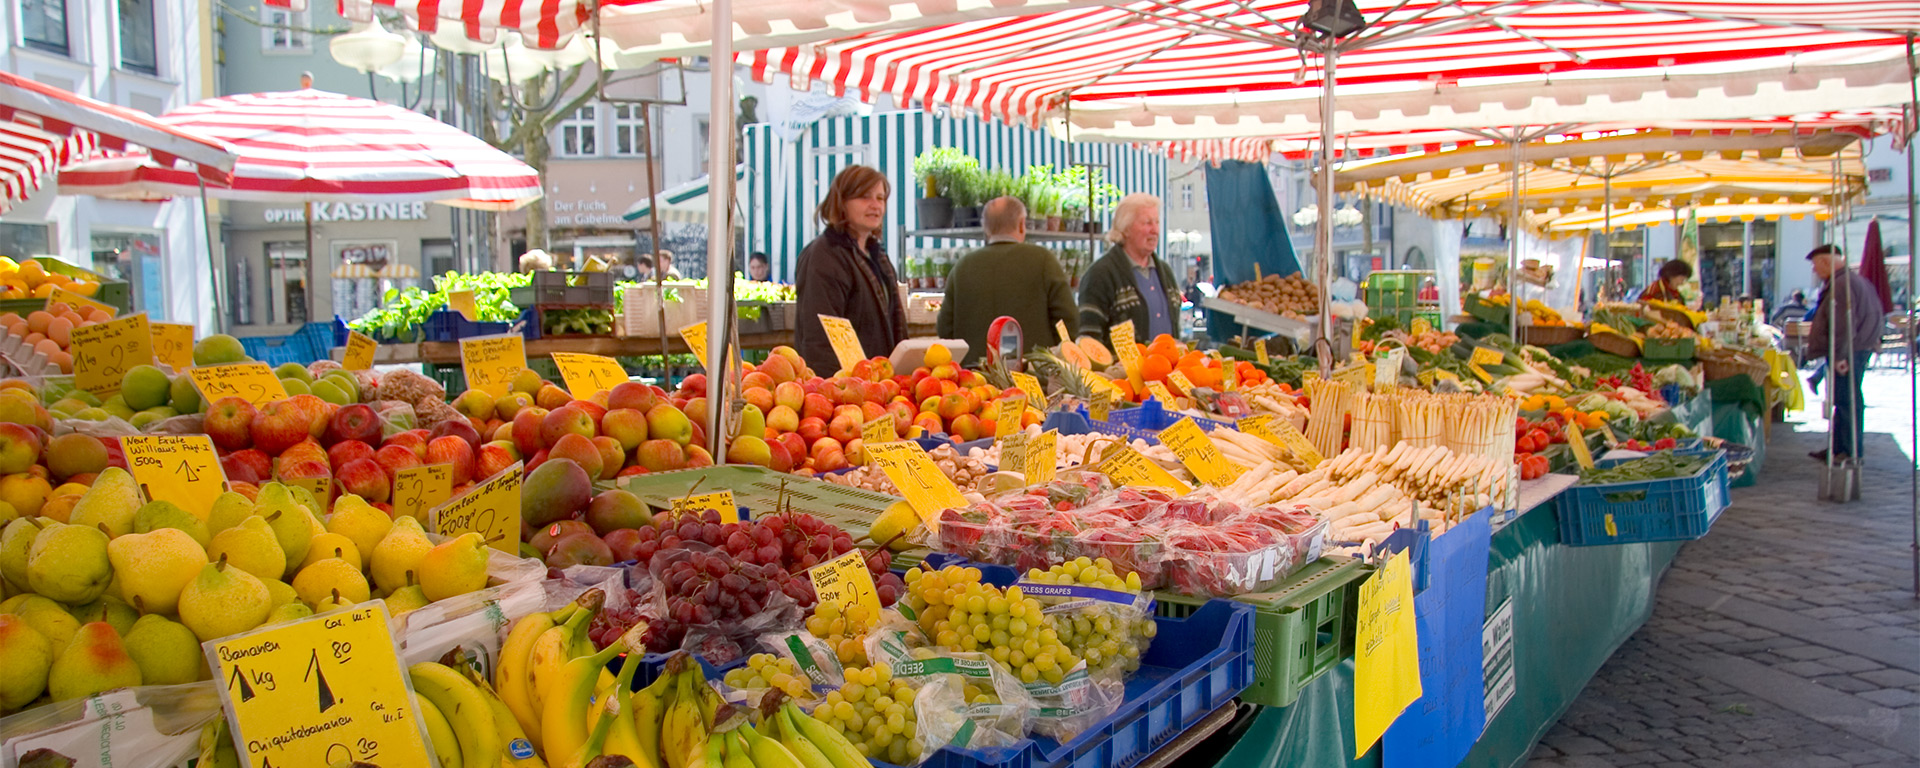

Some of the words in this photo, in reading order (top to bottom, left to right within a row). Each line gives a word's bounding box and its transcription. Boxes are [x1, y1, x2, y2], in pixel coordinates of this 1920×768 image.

[264, 208, 305, 223] OPTIK
[311, 201, 427, 222] KASTNER
[554, 200, 574, 212] Der
[577, 200, 606, 212] Fuchs
[554, 214, 571, 225] am
[126, 436, 149, 446] Neue
[130, 445, 177, 455] Williams
[134, 456, 163, 469] 500g
[437, 493, 480, 526] Kernlose
[1044, 587, 1072, 595] GRAPES
[219, 640, 281, 662] Bananen
[248, 715, 354, 754] Chiquitabananen
